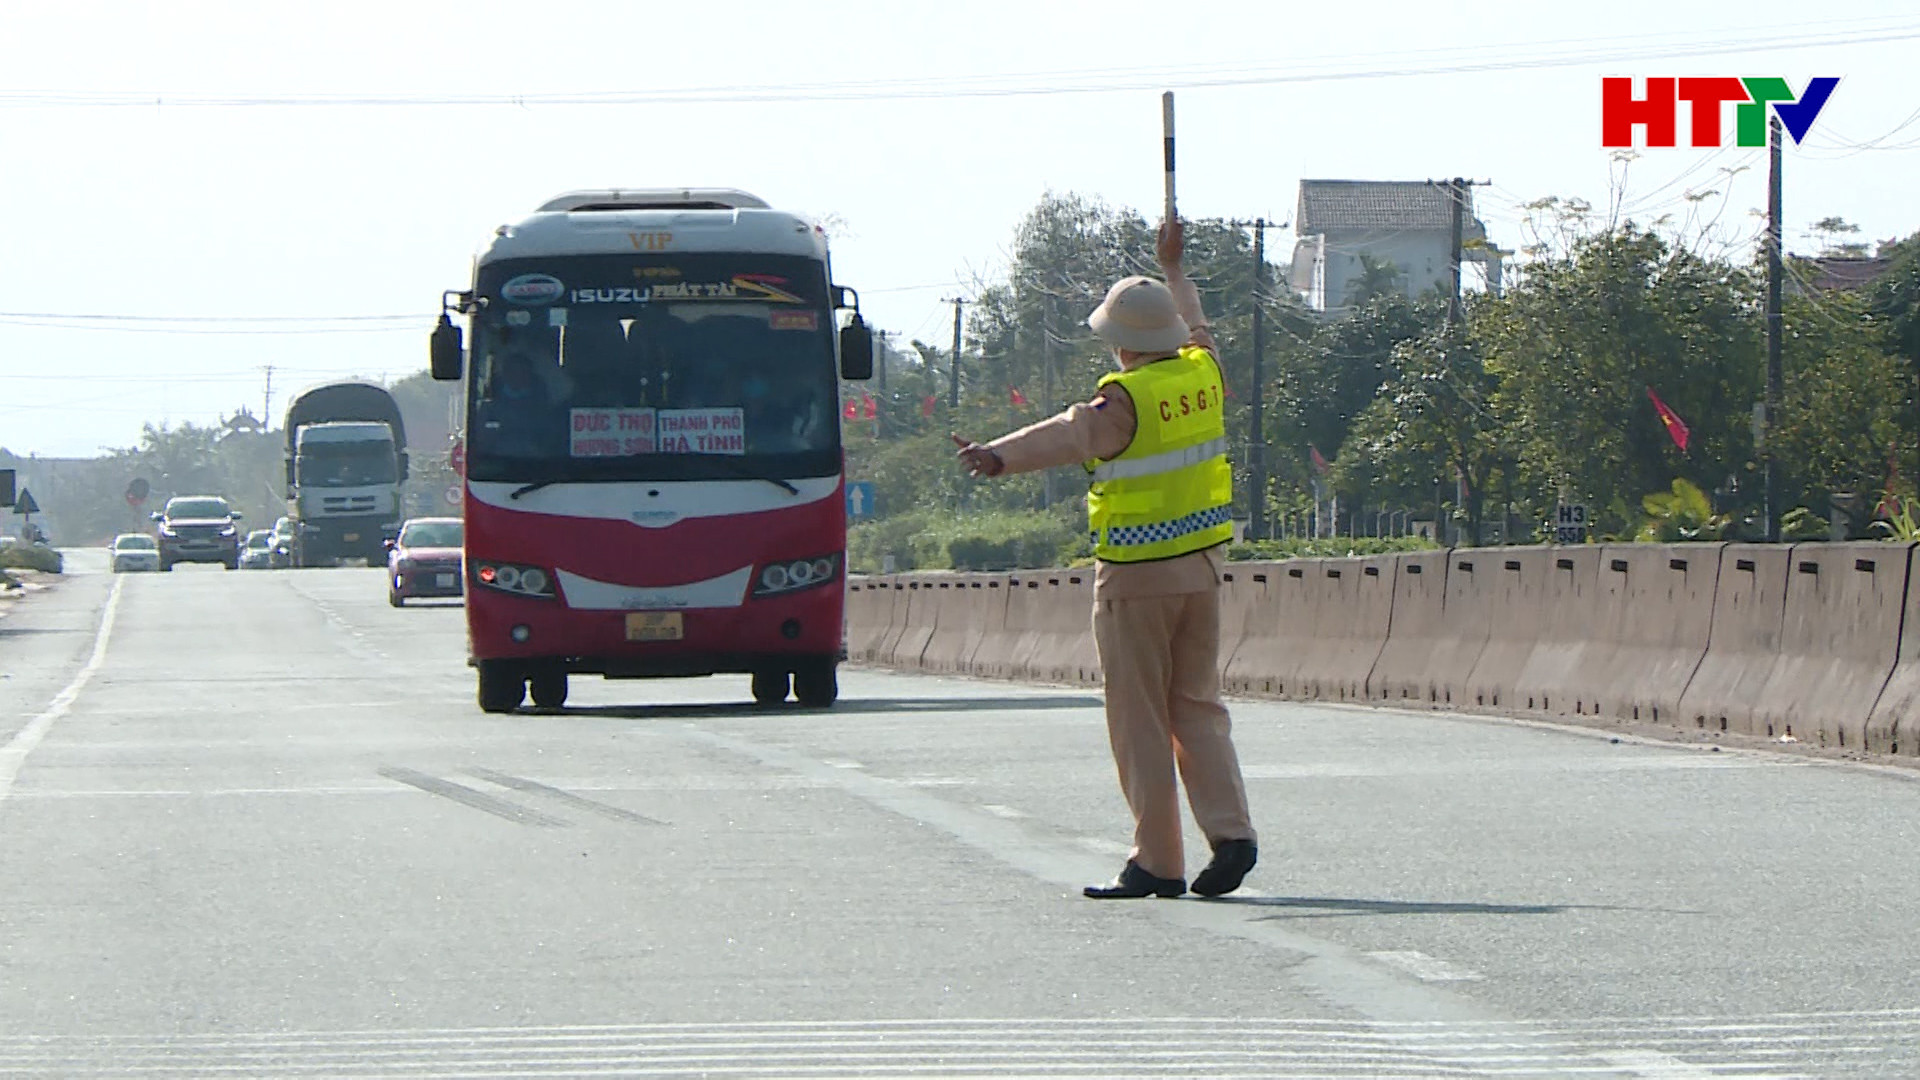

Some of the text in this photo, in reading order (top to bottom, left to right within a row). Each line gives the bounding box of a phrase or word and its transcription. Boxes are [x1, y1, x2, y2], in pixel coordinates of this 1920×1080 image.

[628, 233, 673, 250] VIP
[571, 288, 650, 304] ISUZU
[662, 434, 690, 452] HÀ
[1559, 505, 1585, 523] H3
